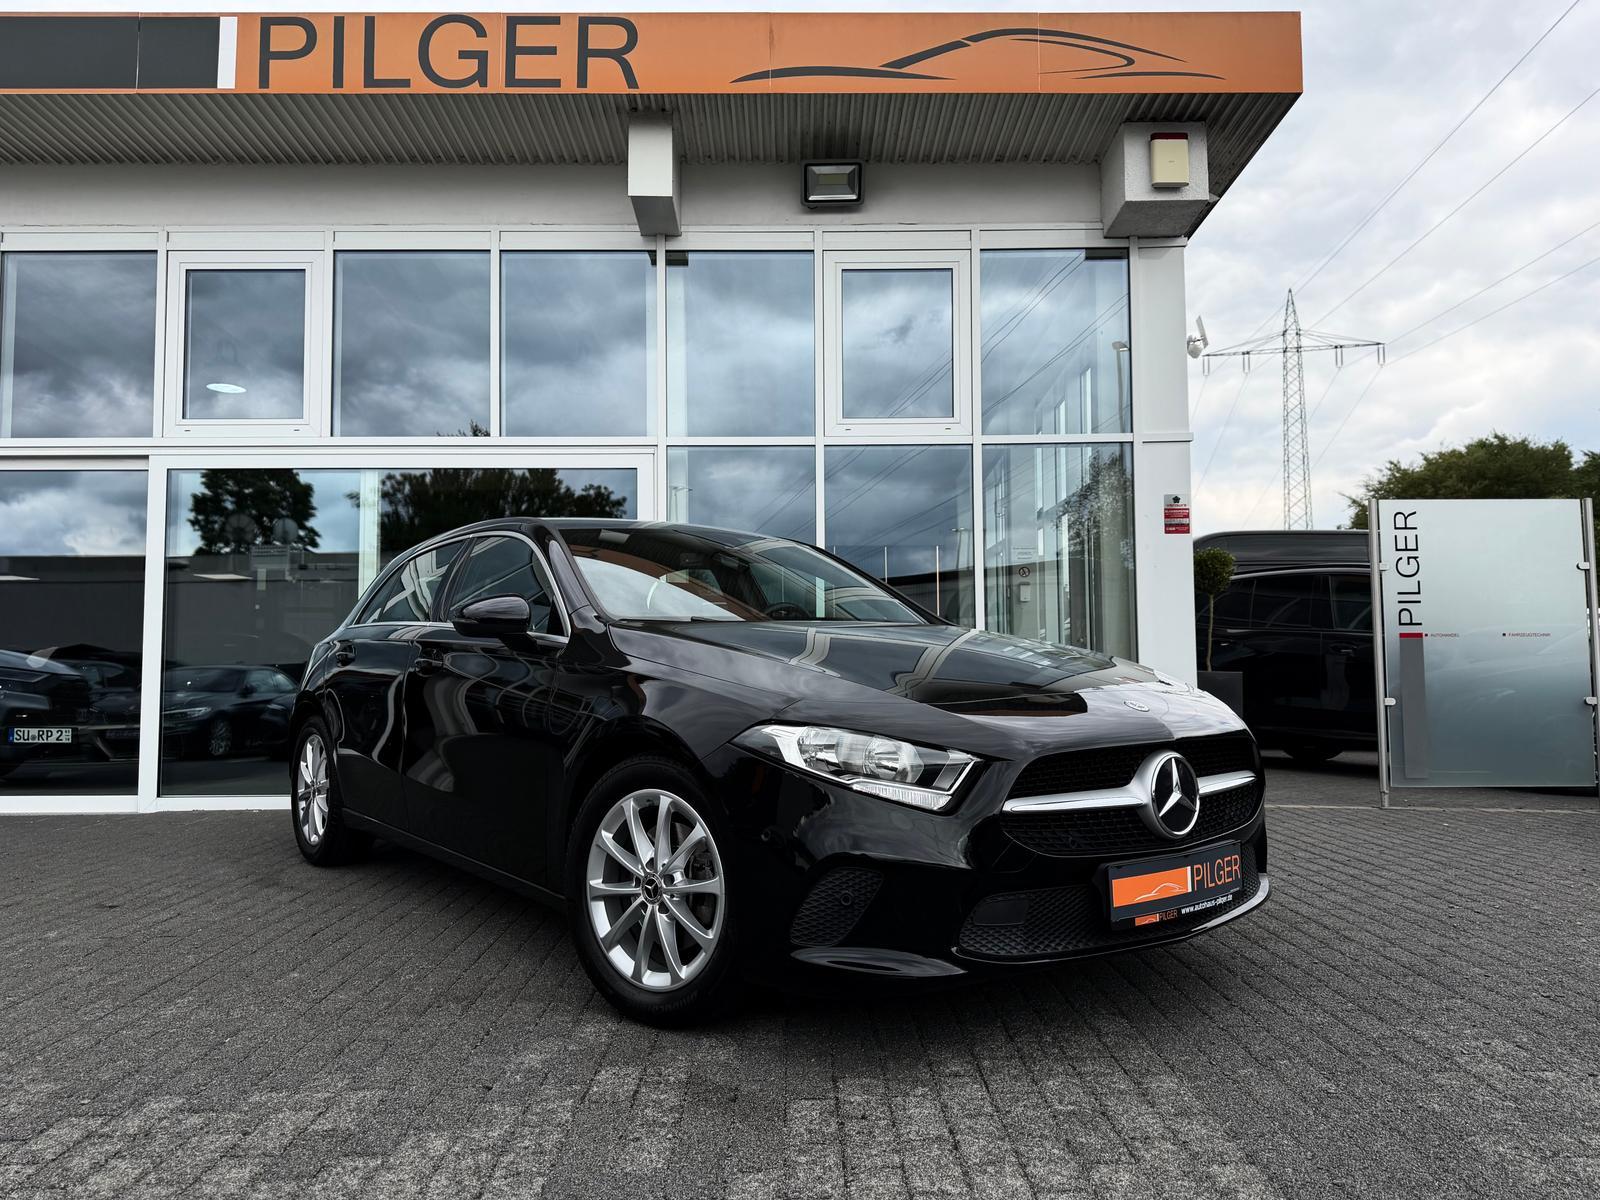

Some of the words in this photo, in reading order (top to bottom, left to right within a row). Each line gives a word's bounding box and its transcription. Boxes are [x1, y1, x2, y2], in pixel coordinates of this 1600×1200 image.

[258, 14, 640, 90] PILGER
[1393, 510, 1423, 627] PILGER
[14, 729, 30, 742] SU
[37, 729, 53, 741] RP
[56, 729, 64, 741] 2
[1193, 854, 1241, 891] PILGER
[1160, 909, 1178, 921] PILGER
[1181, 894, 1233, 914] www.autohaus-pilger.de
